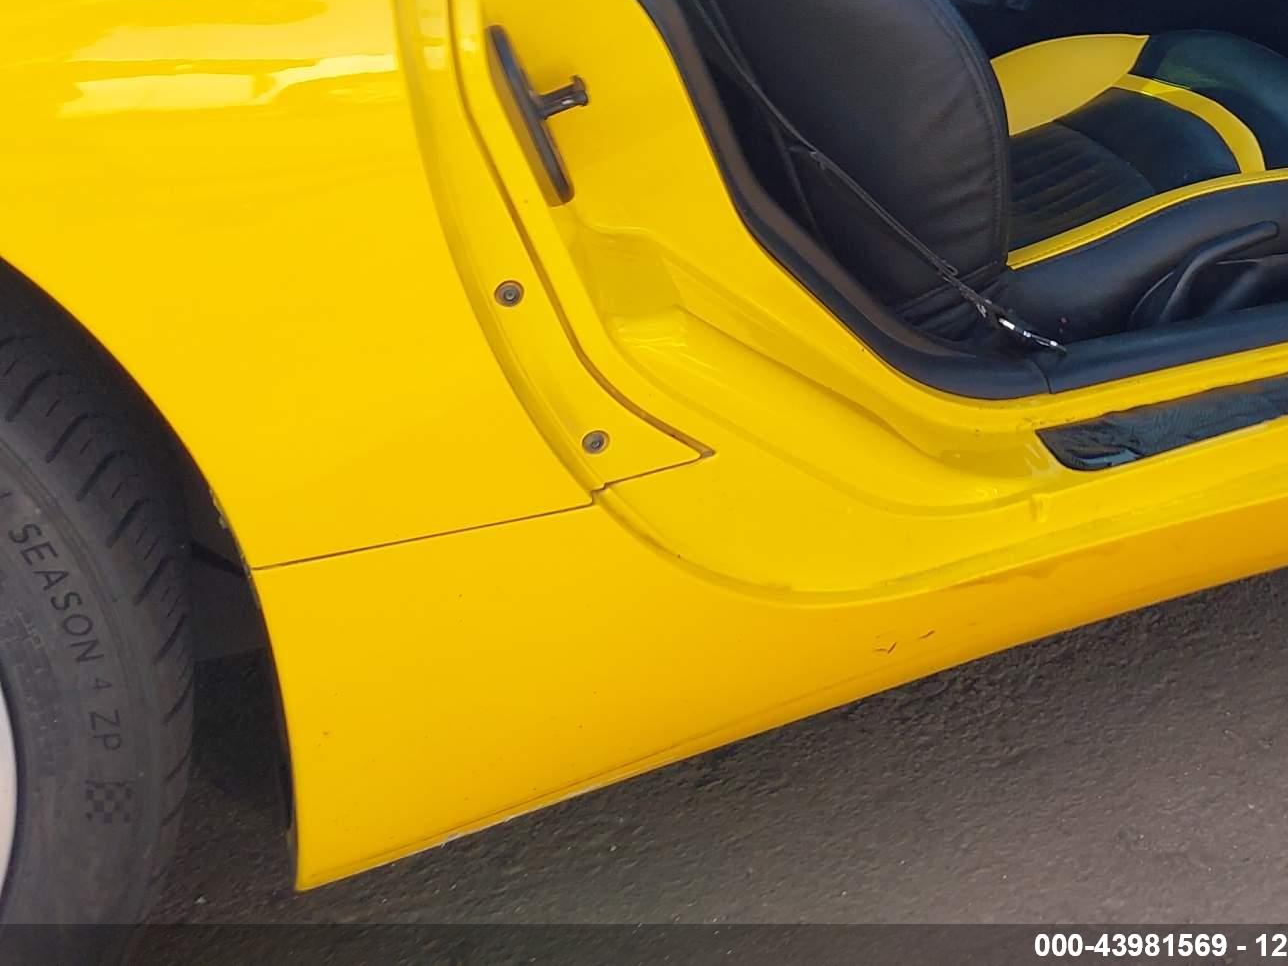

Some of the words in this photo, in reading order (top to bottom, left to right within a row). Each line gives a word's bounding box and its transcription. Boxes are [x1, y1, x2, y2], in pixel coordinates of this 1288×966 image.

[8, 522, 104, 663] SEASON
[92, 677, 112, 690] 4
[89, 709, 122, 752] ZP
